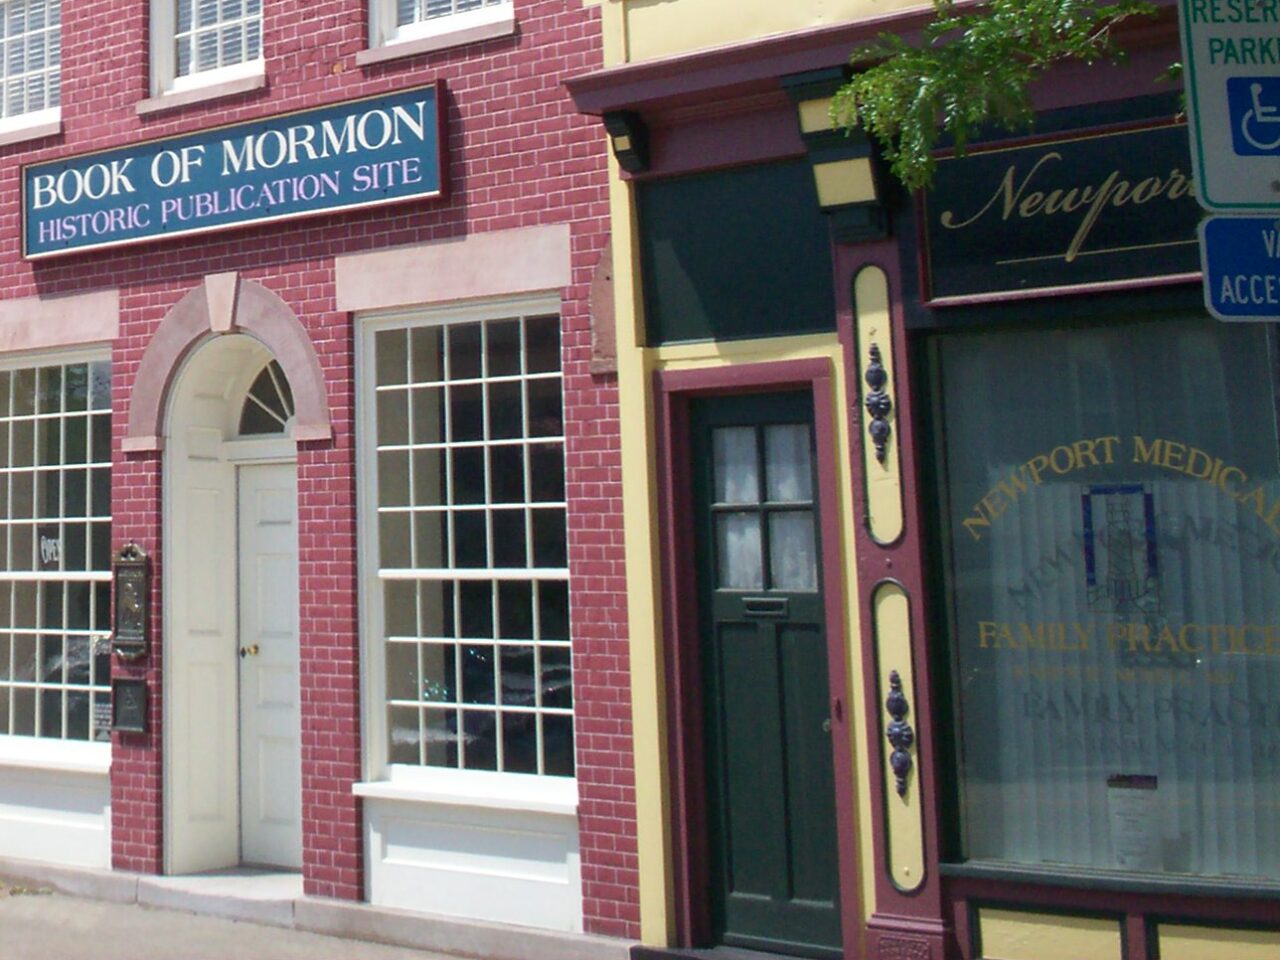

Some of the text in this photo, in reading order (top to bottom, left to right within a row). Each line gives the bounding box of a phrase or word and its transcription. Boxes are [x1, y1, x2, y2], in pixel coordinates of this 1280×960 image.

[32, 101, 427, 210] BOOK OF MORMON
[38, 157, 422, 244] HISTORIC PUBLICATION SITE
[940, 152, 1196, 262] Newpor
[1220, 274, 1280, 304] ACCE
[962, 436, 1121, 541] NEWPORT
[978, 620, 1096, 651] FAMILY
